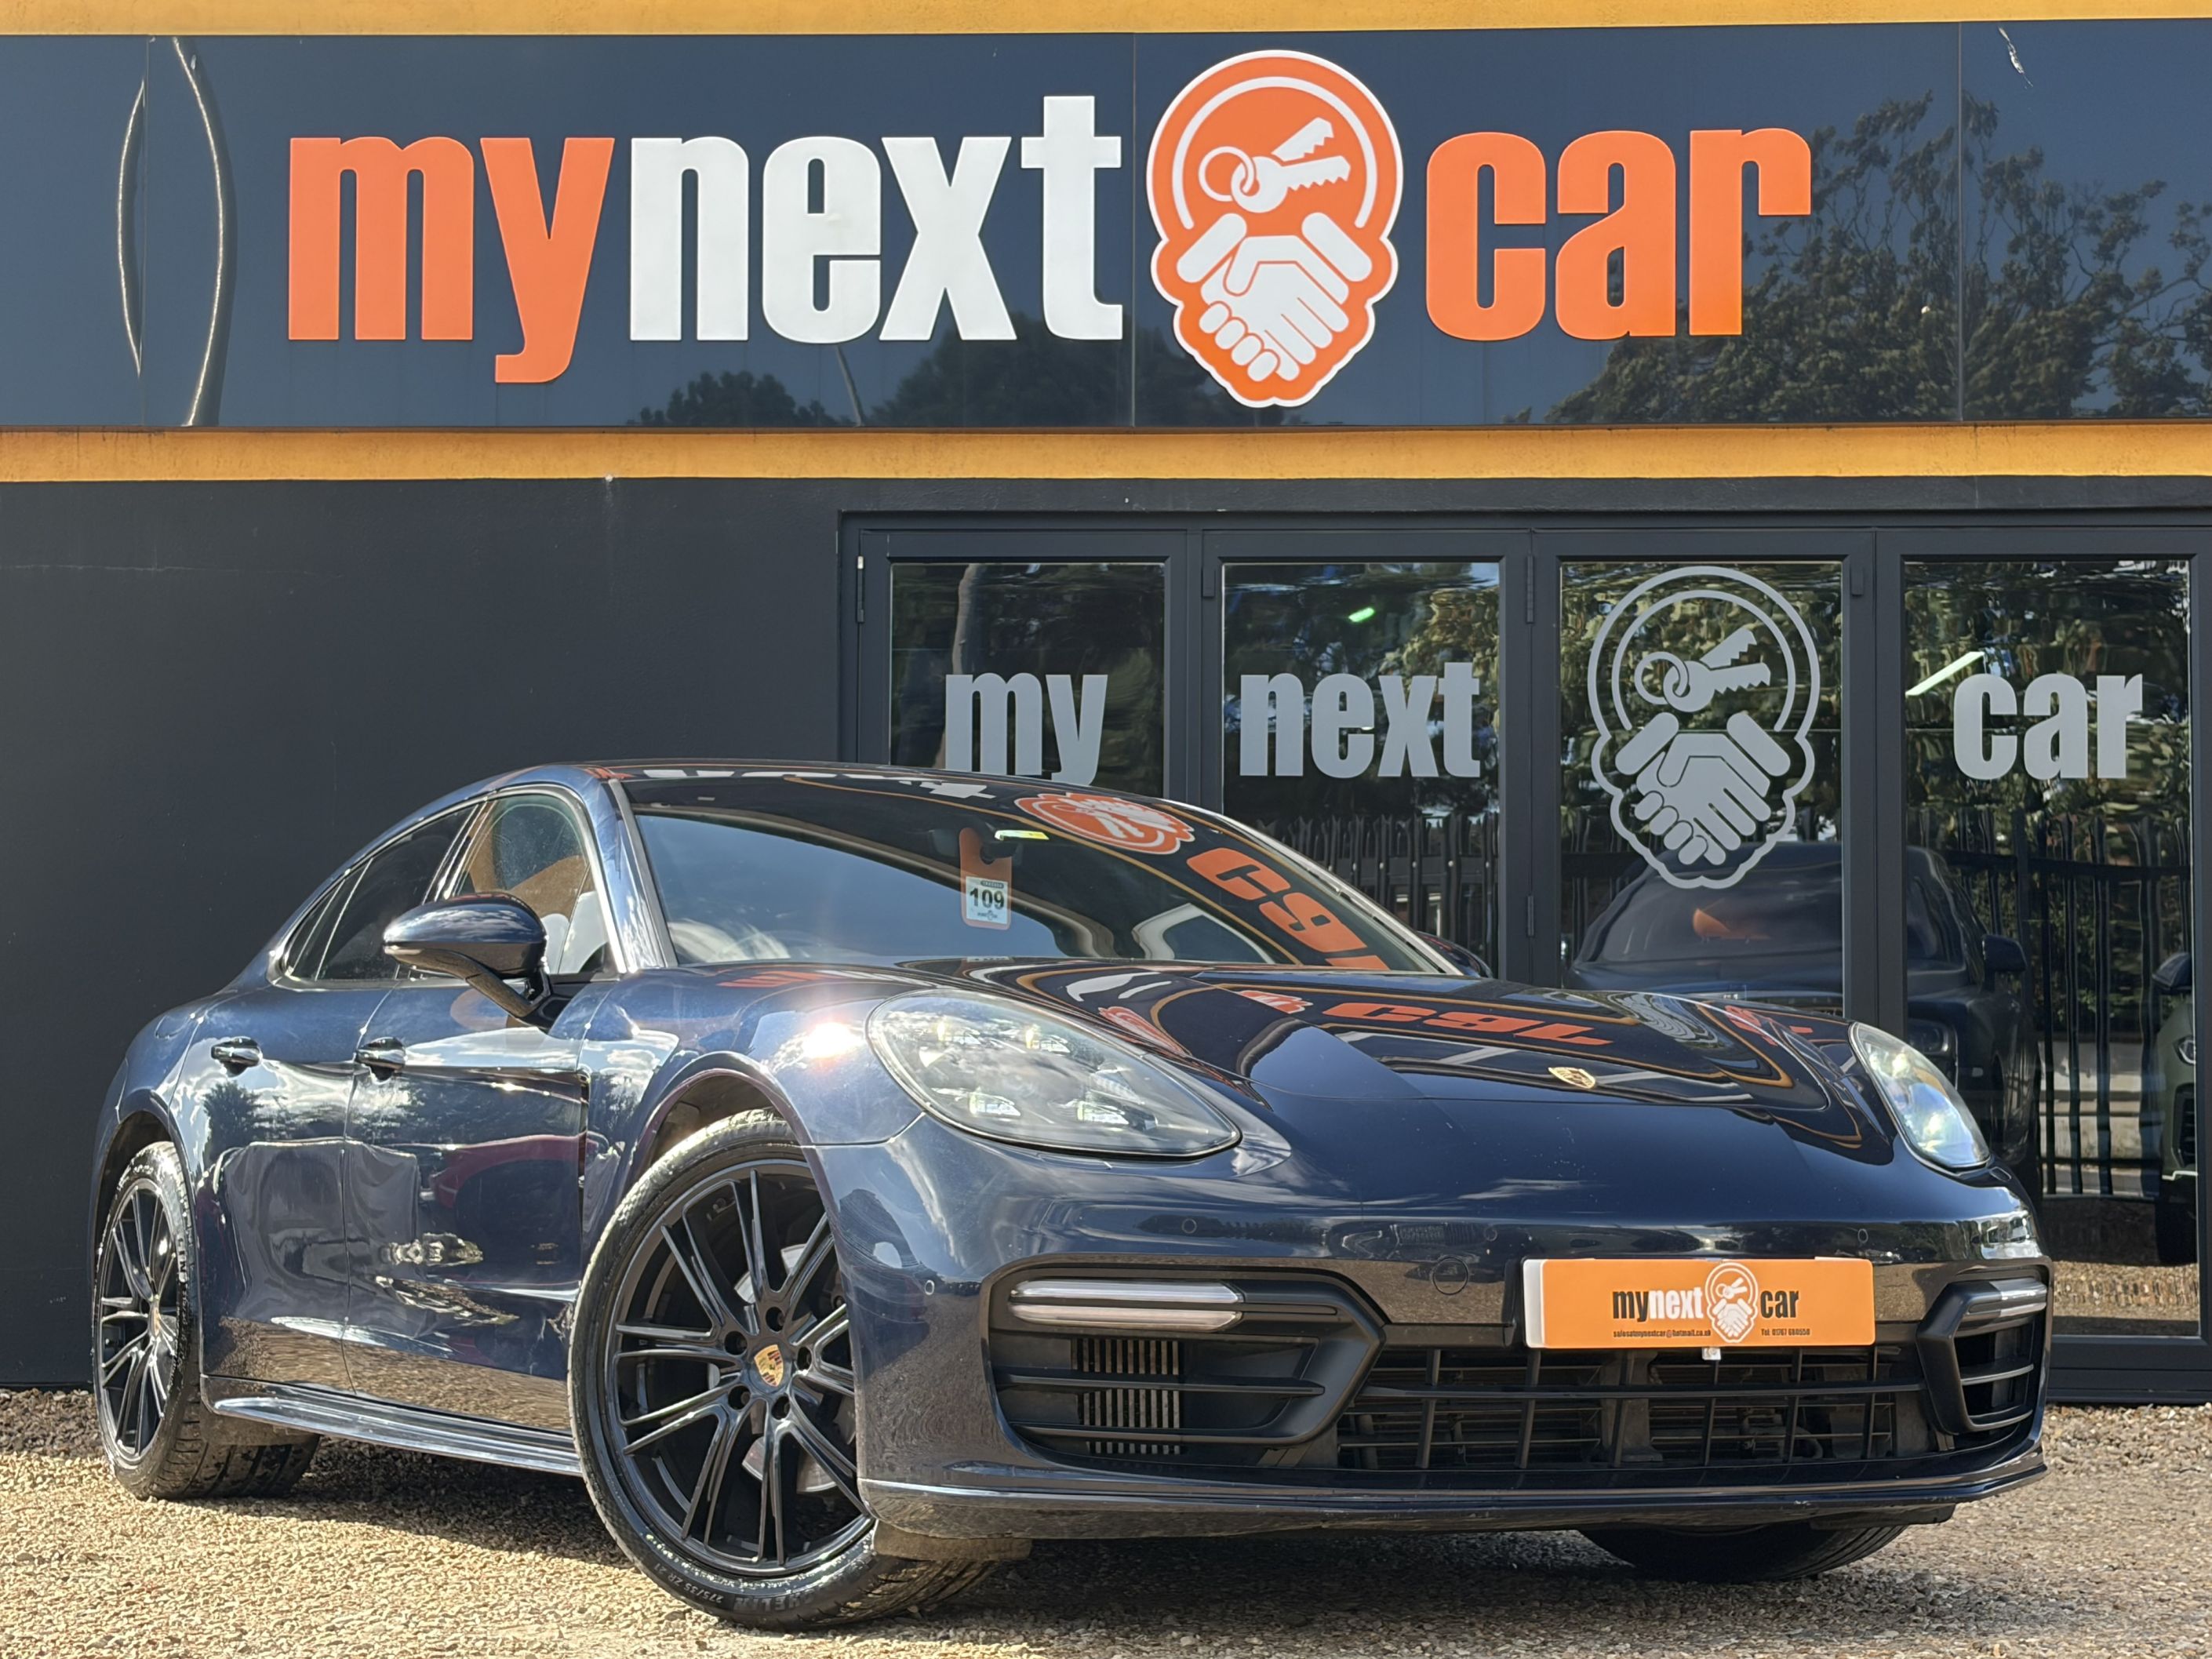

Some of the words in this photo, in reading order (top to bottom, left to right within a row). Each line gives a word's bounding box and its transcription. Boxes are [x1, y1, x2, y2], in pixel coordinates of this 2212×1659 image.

[1425, 128, 1812, 342] car
[945, 672, 1108, 785] my
[1239, 662, 1481, 779] next
[1953, 673, 2143, 780] car
[970, 887, 1005, 910] 109
[1759, 1290, 1800, 1319] car
